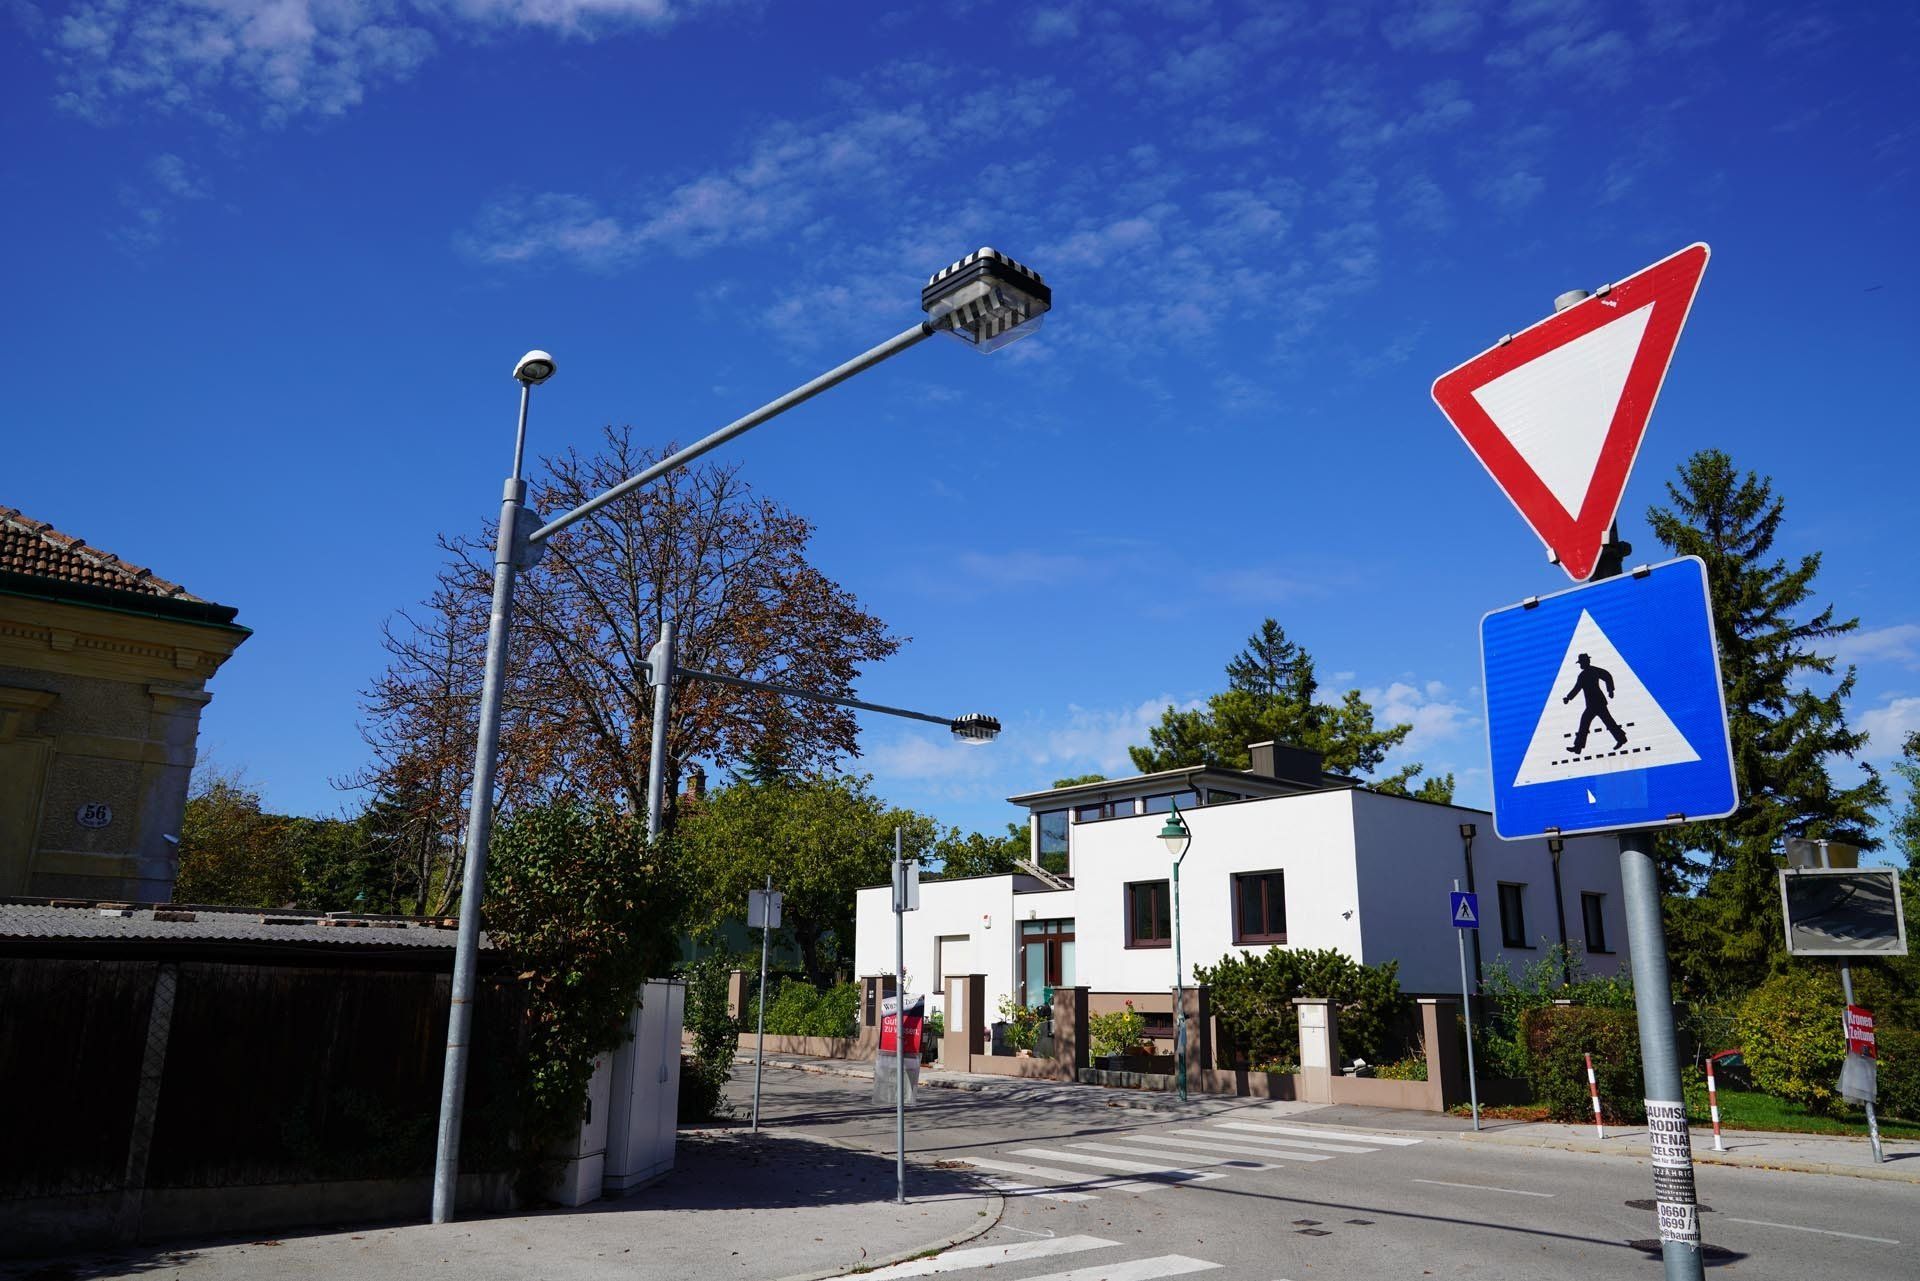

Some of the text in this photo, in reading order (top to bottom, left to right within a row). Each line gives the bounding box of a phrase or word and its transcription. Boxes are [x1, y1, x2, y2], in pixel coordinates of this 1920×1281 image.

[85, 804, 106, 820] 56
[1848, 1011, 1873, 1027] Kronen
[1849, 1026, 1875, 1044] Zeitung
[1660, 1205, 1687, 1218] 0660
[1660, 1217, 1686, 1230] 0699
